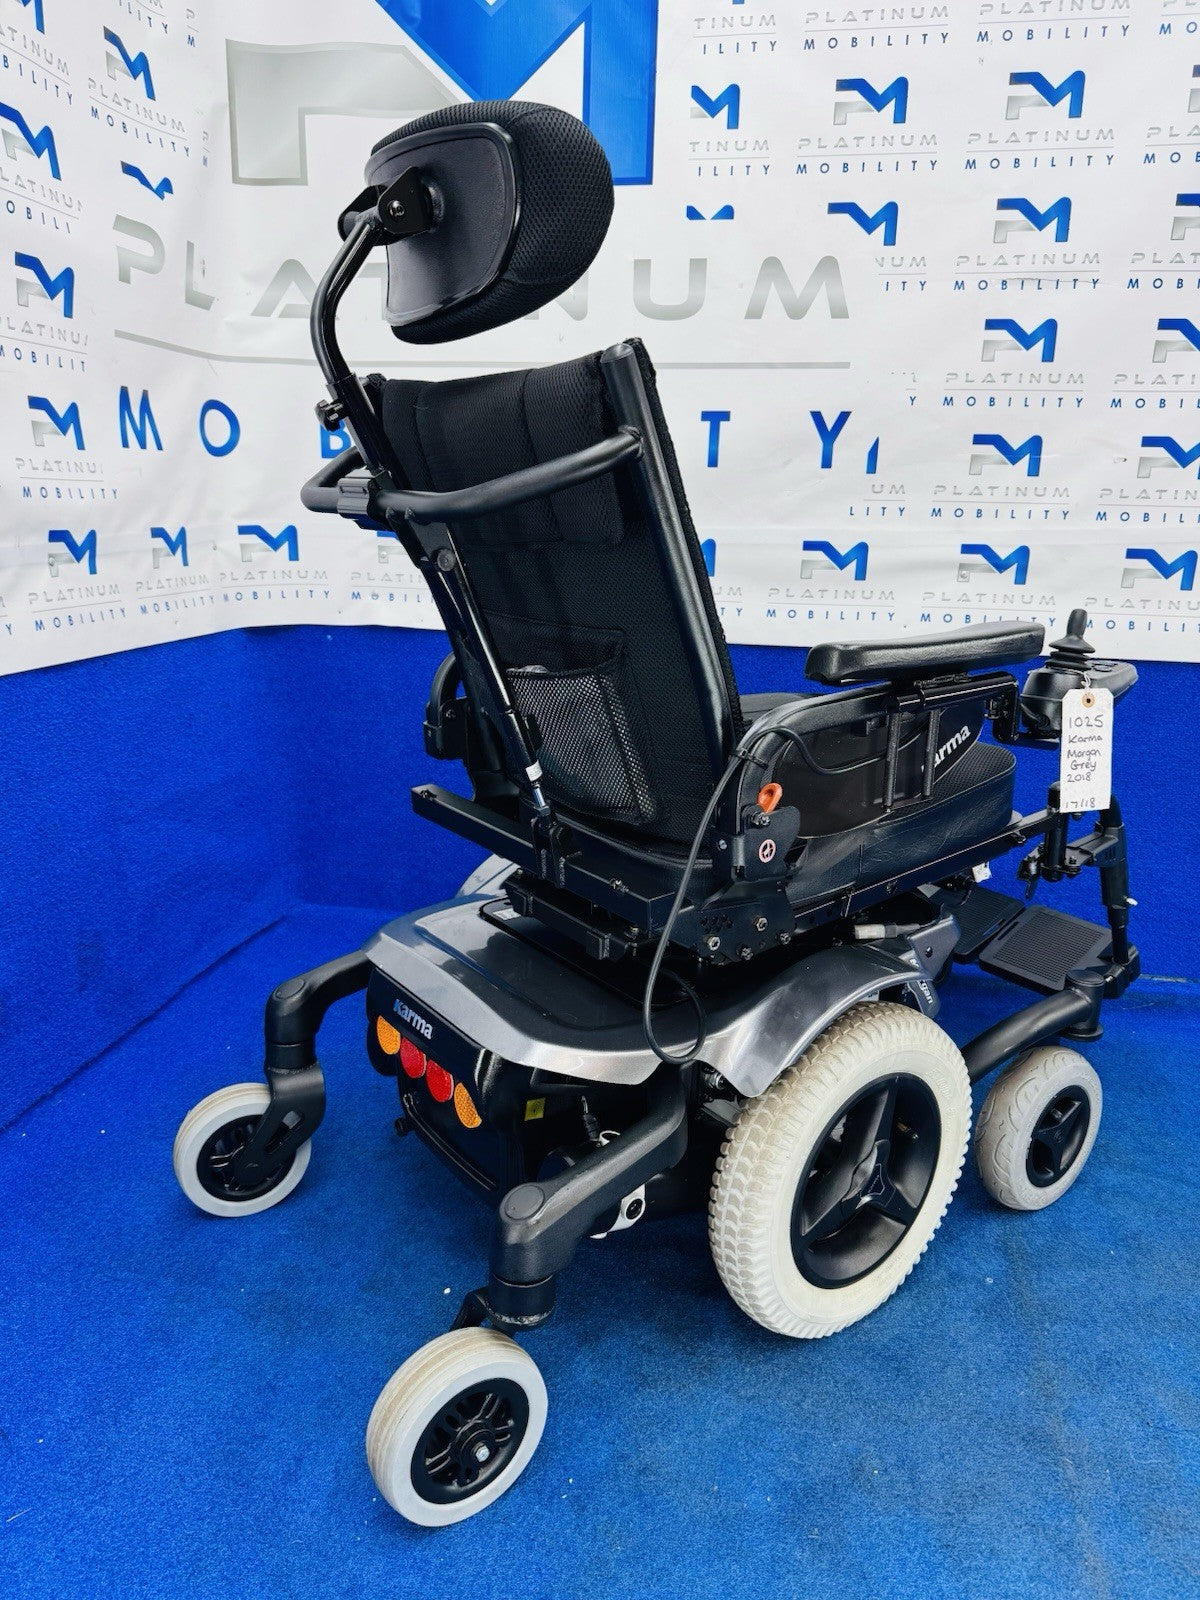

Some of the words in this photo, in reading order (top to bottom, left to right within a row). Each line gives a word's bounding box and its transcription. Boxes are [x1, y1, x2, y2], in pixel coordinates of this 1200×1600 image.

[804, 5, 949, 24] PLATINUM
[976, 24, 1130, 43] MOBILITY
[803, 32, 949, 51] MOBILITY
[87, 77, 186, 133] PLATINUM
[91, 105, 190, 157] MOBILITY
[967, 128, 1116, 145] PLATINUM
[798, 133, 938, 150] PLATINUM
[796, 159, 938, 175] MOBILITY
[965, 154, 1115, 170] MOBILITY
[956, 252, 1101, 267] PLATINUM
[953, 277, 1101, 292] MOBILITY
[945, 372, 1085, 385] PLATINUM
[942, 395, 1084, 409] MOBILITY
[22, 486, 118, 500] MOBILITY
[933, 484, 1070, 498] PLATINUM
[931, 507, 1070, 520] MOBILITY
[136, 574, 210, 593] PLATINUM
[219, 569, 329, 583] PLATINUM
[28, 583, 121, 605] PLATINUM
[222, 590, 330, 602] MOBILITY
[768, 587, 896, 601] PLATINUM
[921, 591, 1057, 606] PLATINUM
[35, 607, 126, 632] MOBILITY
[766, 608, 895, 622] MOBILITY
[1069, 714, 1104, 729] 1025
[1067, 748, 1102, 761] Morgan
[1070, 759, 1097, 772] Grey
[1067, 771, 1092, 783] 2018
